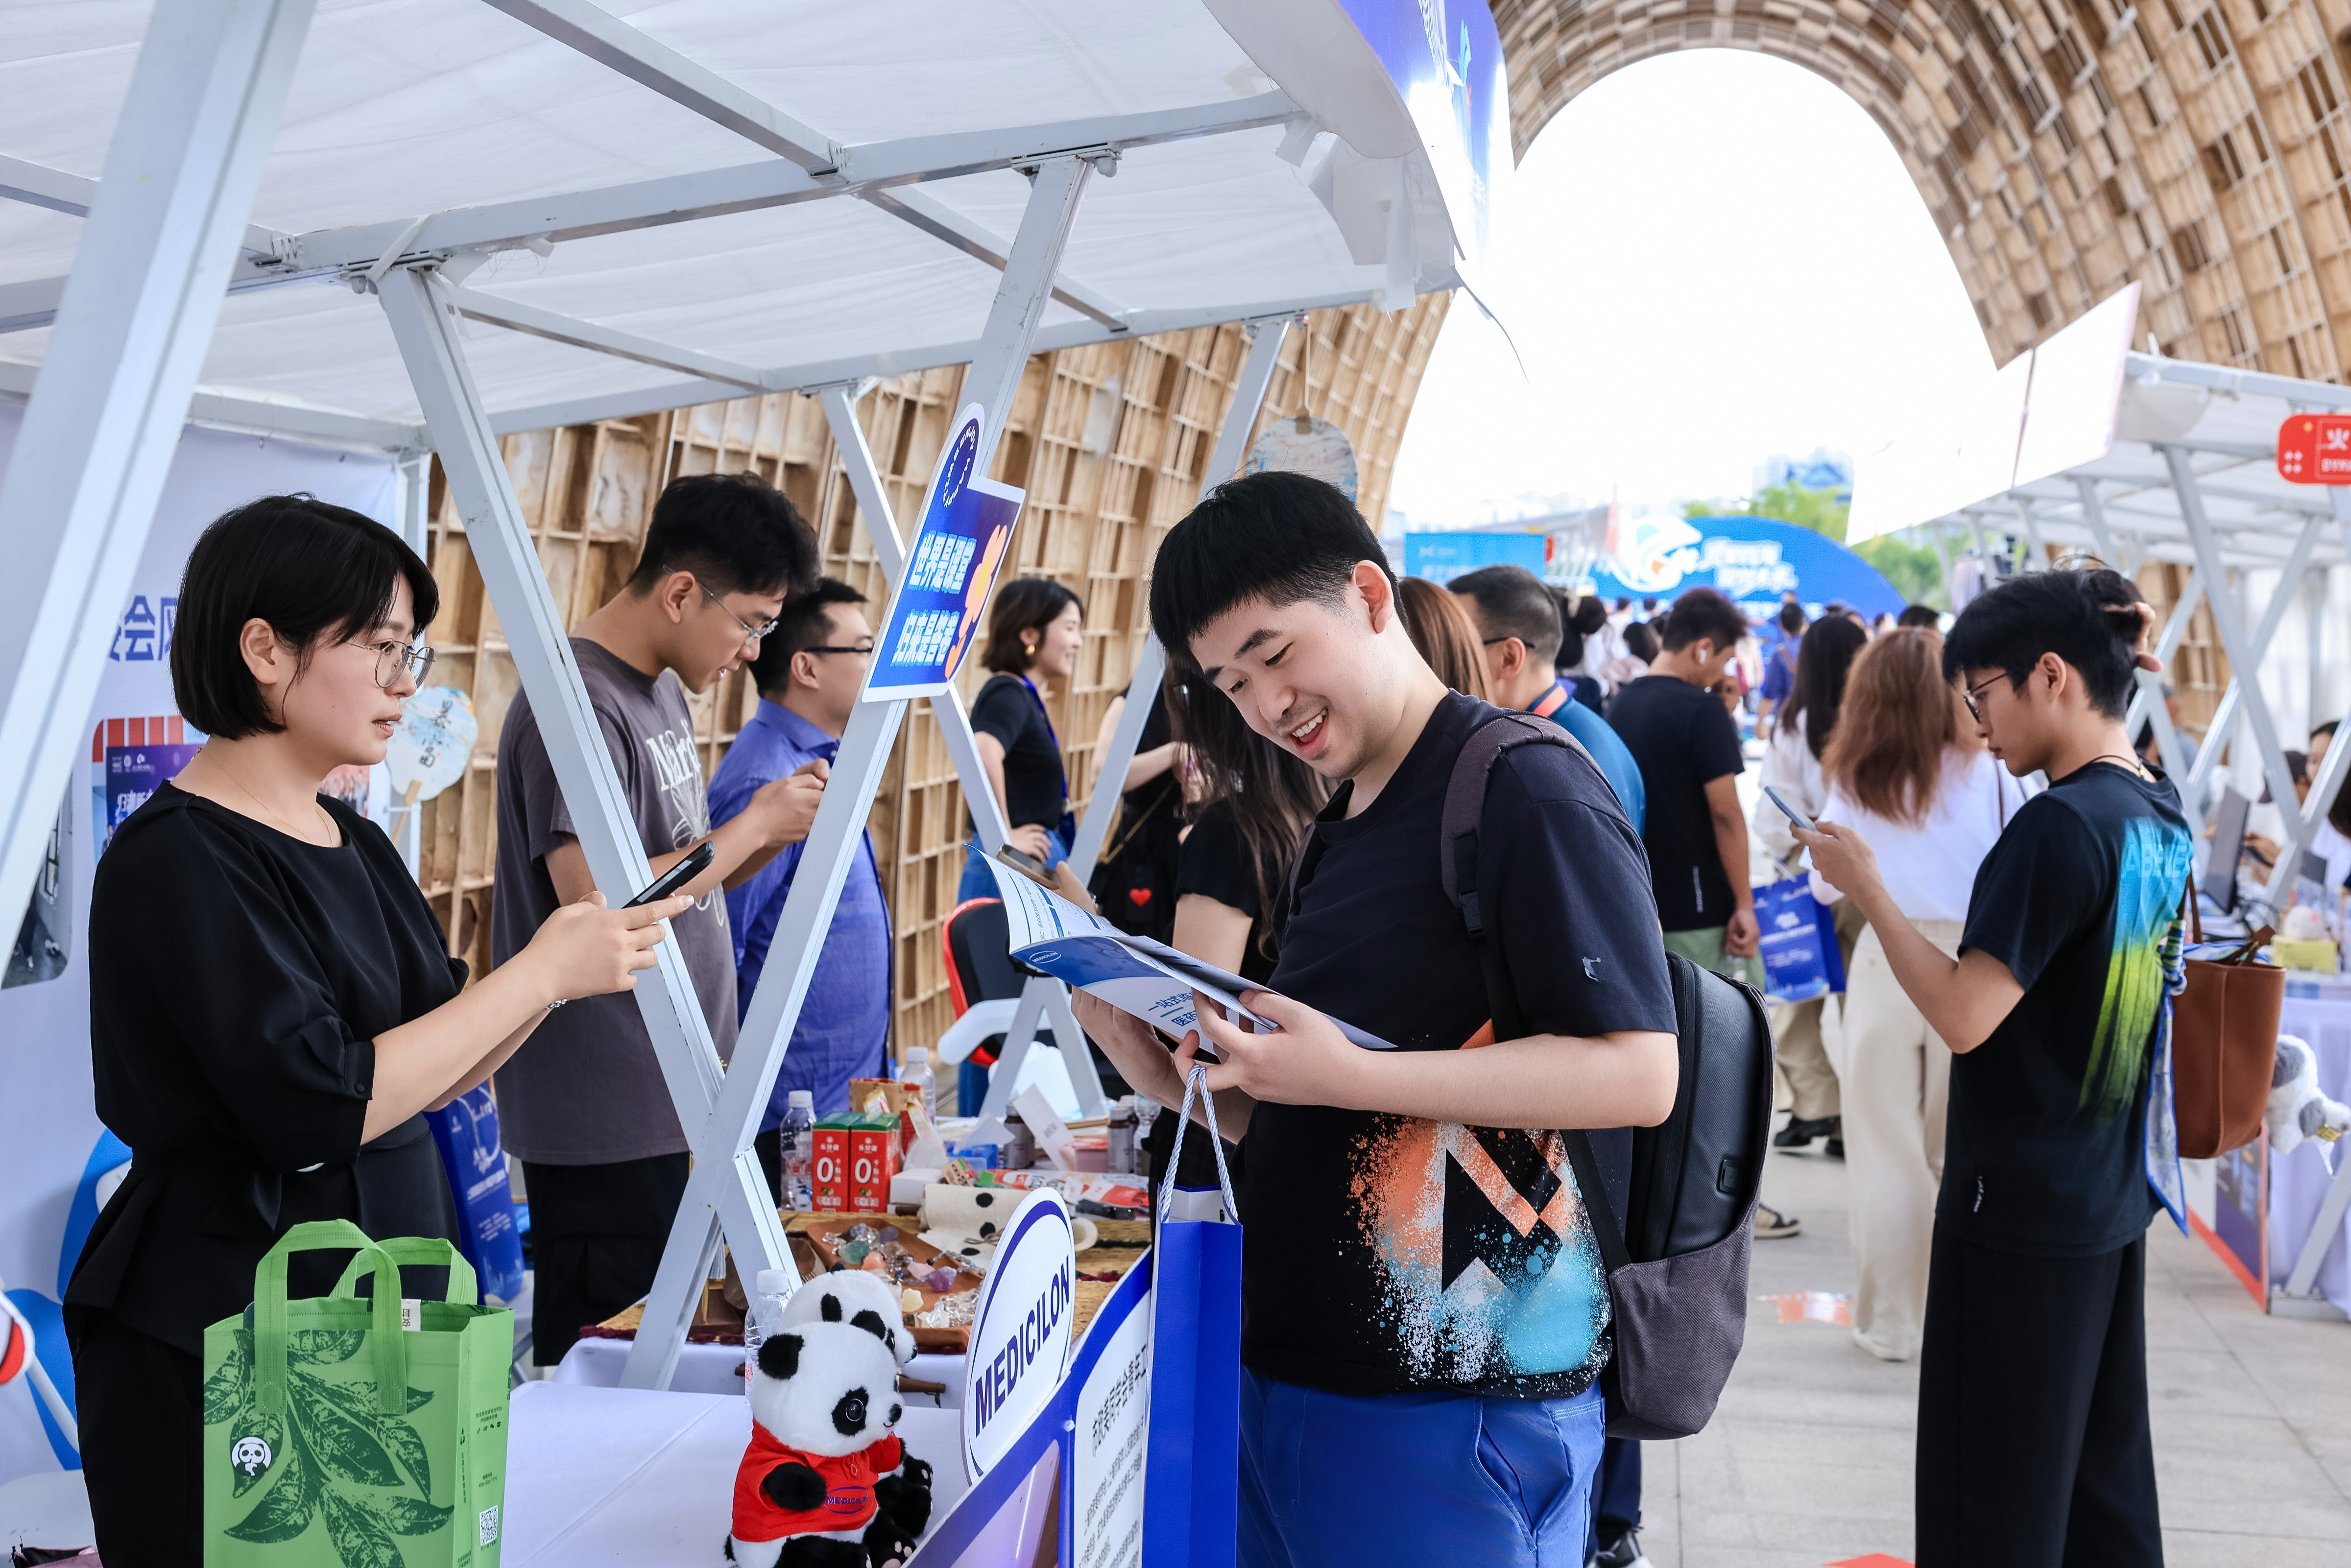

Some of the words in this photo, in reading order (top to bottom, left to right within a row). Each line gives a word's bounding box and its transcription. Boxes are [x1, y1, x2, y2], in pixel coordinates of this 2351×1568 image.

[907, 529, 977, 594] 世界是课堂
[889, 609, 960, 667] 归来是答卷
[816, 1157, 834, 1183] 0
[854, 1158, 872, 1184] 0
[976, 1254, 1069, 1438] MEDICILON
